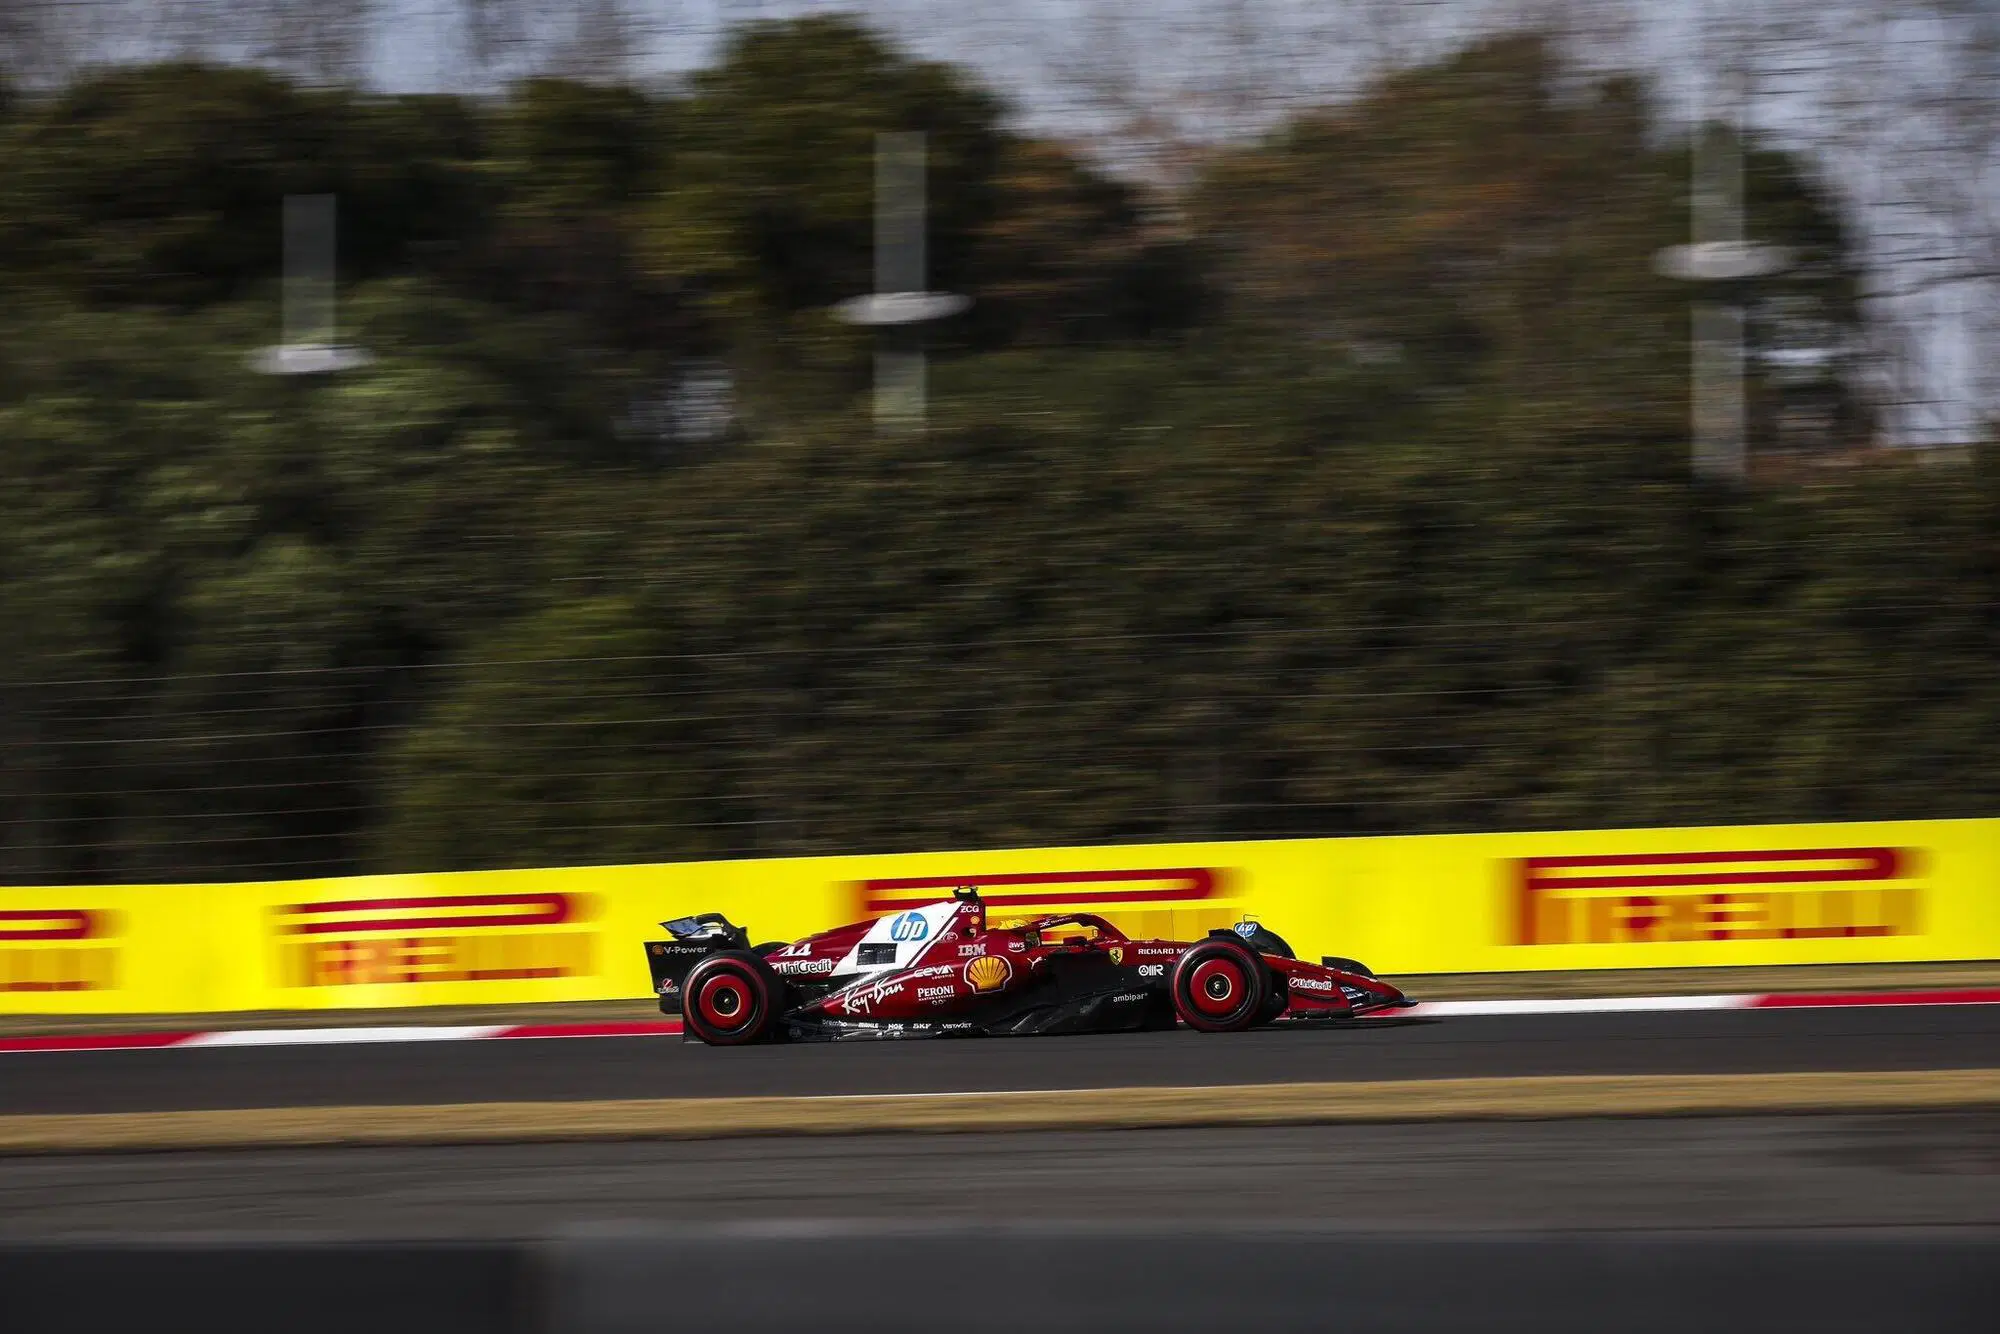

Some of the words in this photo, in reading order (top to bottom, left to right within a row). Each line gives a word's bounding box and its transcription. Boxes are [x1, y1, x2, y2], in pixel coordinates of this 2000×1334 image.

[960, 905, 980, 913] ZCG
[894, 912, 923, 941] hp
[663, 946, 707, 955] V-Power
[958, 944, 986, 956] IBM
[780, 959, 832, 975] UniCredit
[1299, 978, 1332, 991] UniCredit
[917, 985, 955, 998] PERONI
